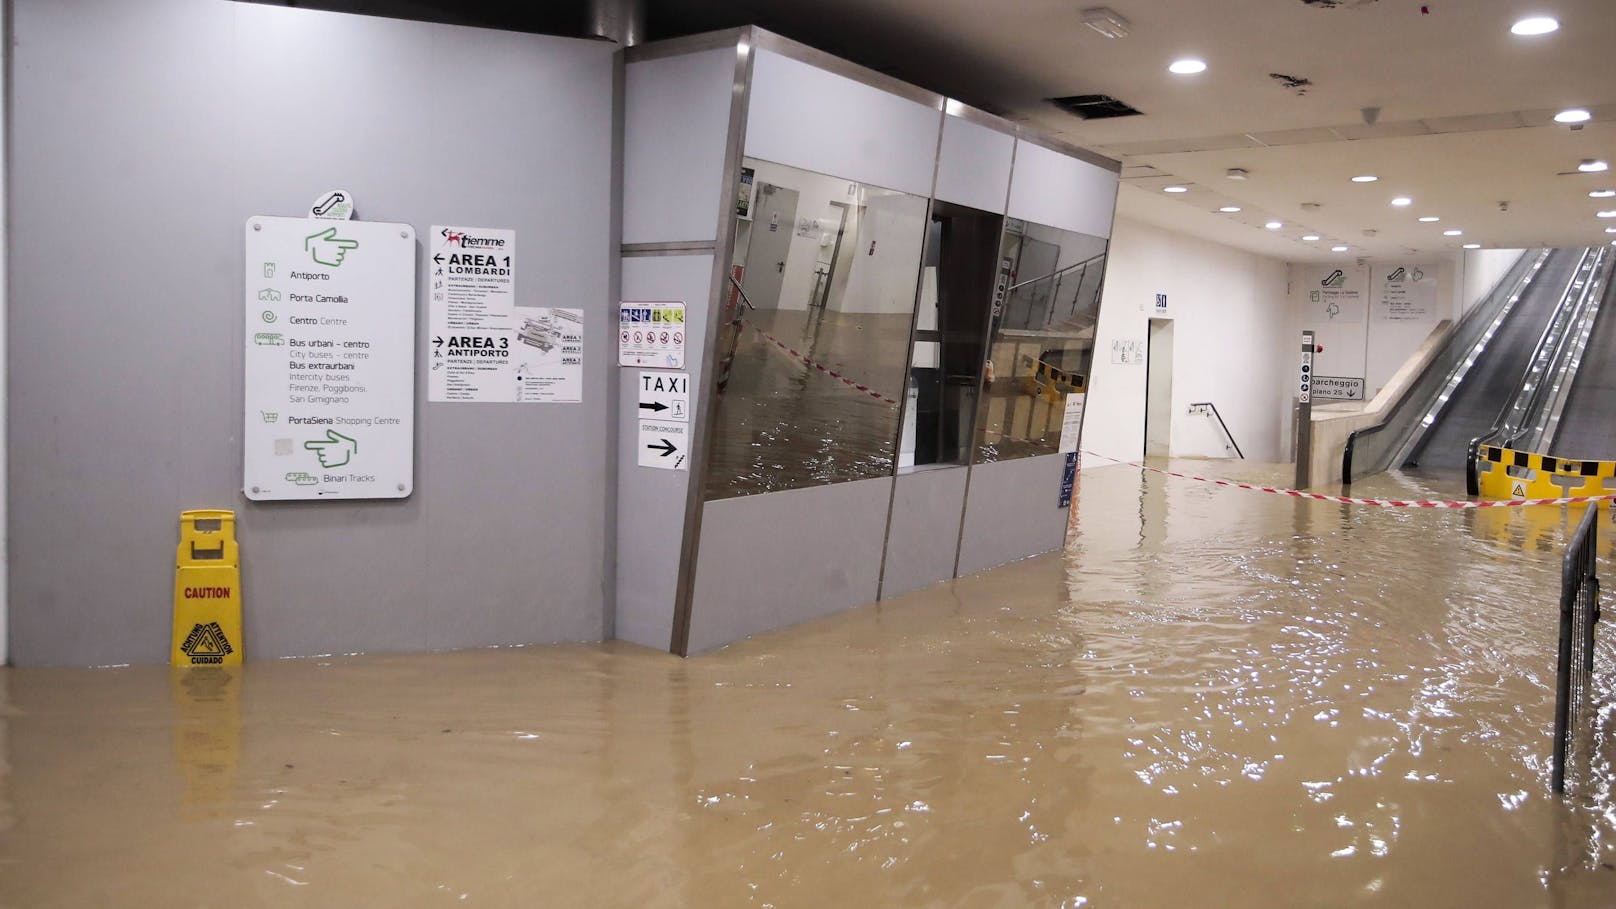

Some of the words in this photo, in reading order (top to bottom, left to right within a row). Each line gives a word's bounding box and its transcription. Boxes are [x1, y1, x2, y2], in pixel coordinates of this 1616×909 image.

[461, 234, 505, 248] tiemme
[449, 253, 497, 266] AREA
[503, 255, 511, 268] 1
[290, 271, 330, 281] Antiporto
[449, 266, 511, 276] LOMBARDI
[290, 293, 314, 303] Porta
[315, 294, 349, 304] Camollia
[289, 316, 318, 325] Centro
[320, 317, 348, 326] Centre
[290, 338, 306, 348] Bus
[308, 338, 334, 348] urbani
[343, 340, 370, 349] centro
[448, 336, 495, 349] AREA
[499, 337, 509, 349] 3
[290, 350, 306, 360] City
[309, 350, 334, 360] buses
[343, 351, 370, 360] centre
[447, 349, 509, 358] ANTIPORTO
[289, 361, 306, 370] Bus
[308, 361, 355, 370] extraurbani
[289, 373, 323, 382] Intercity
[325, 373, 350, 382] buses
[643, 376, 686, 394] TAXI
[1312, 389, 1332, 397] piano
[289, 395, 306, 404] San
[307, 395, 350, 406] Gimignano
[288, 416, 334, 426] PortaSiena
[335, 416, 373, 427] Shopping
[374, 416, 401, 426] Centre
[323, 474, 348, 483] Binari
[349, 473, 376, 482] Tracks
[184, 587, 231, 599] CAUTION
[180, 623, 204, 653] ACHTUNG
[209, 621, 234, 655] ATTENTION
[191, 657, 223, 665] CUIDADO
